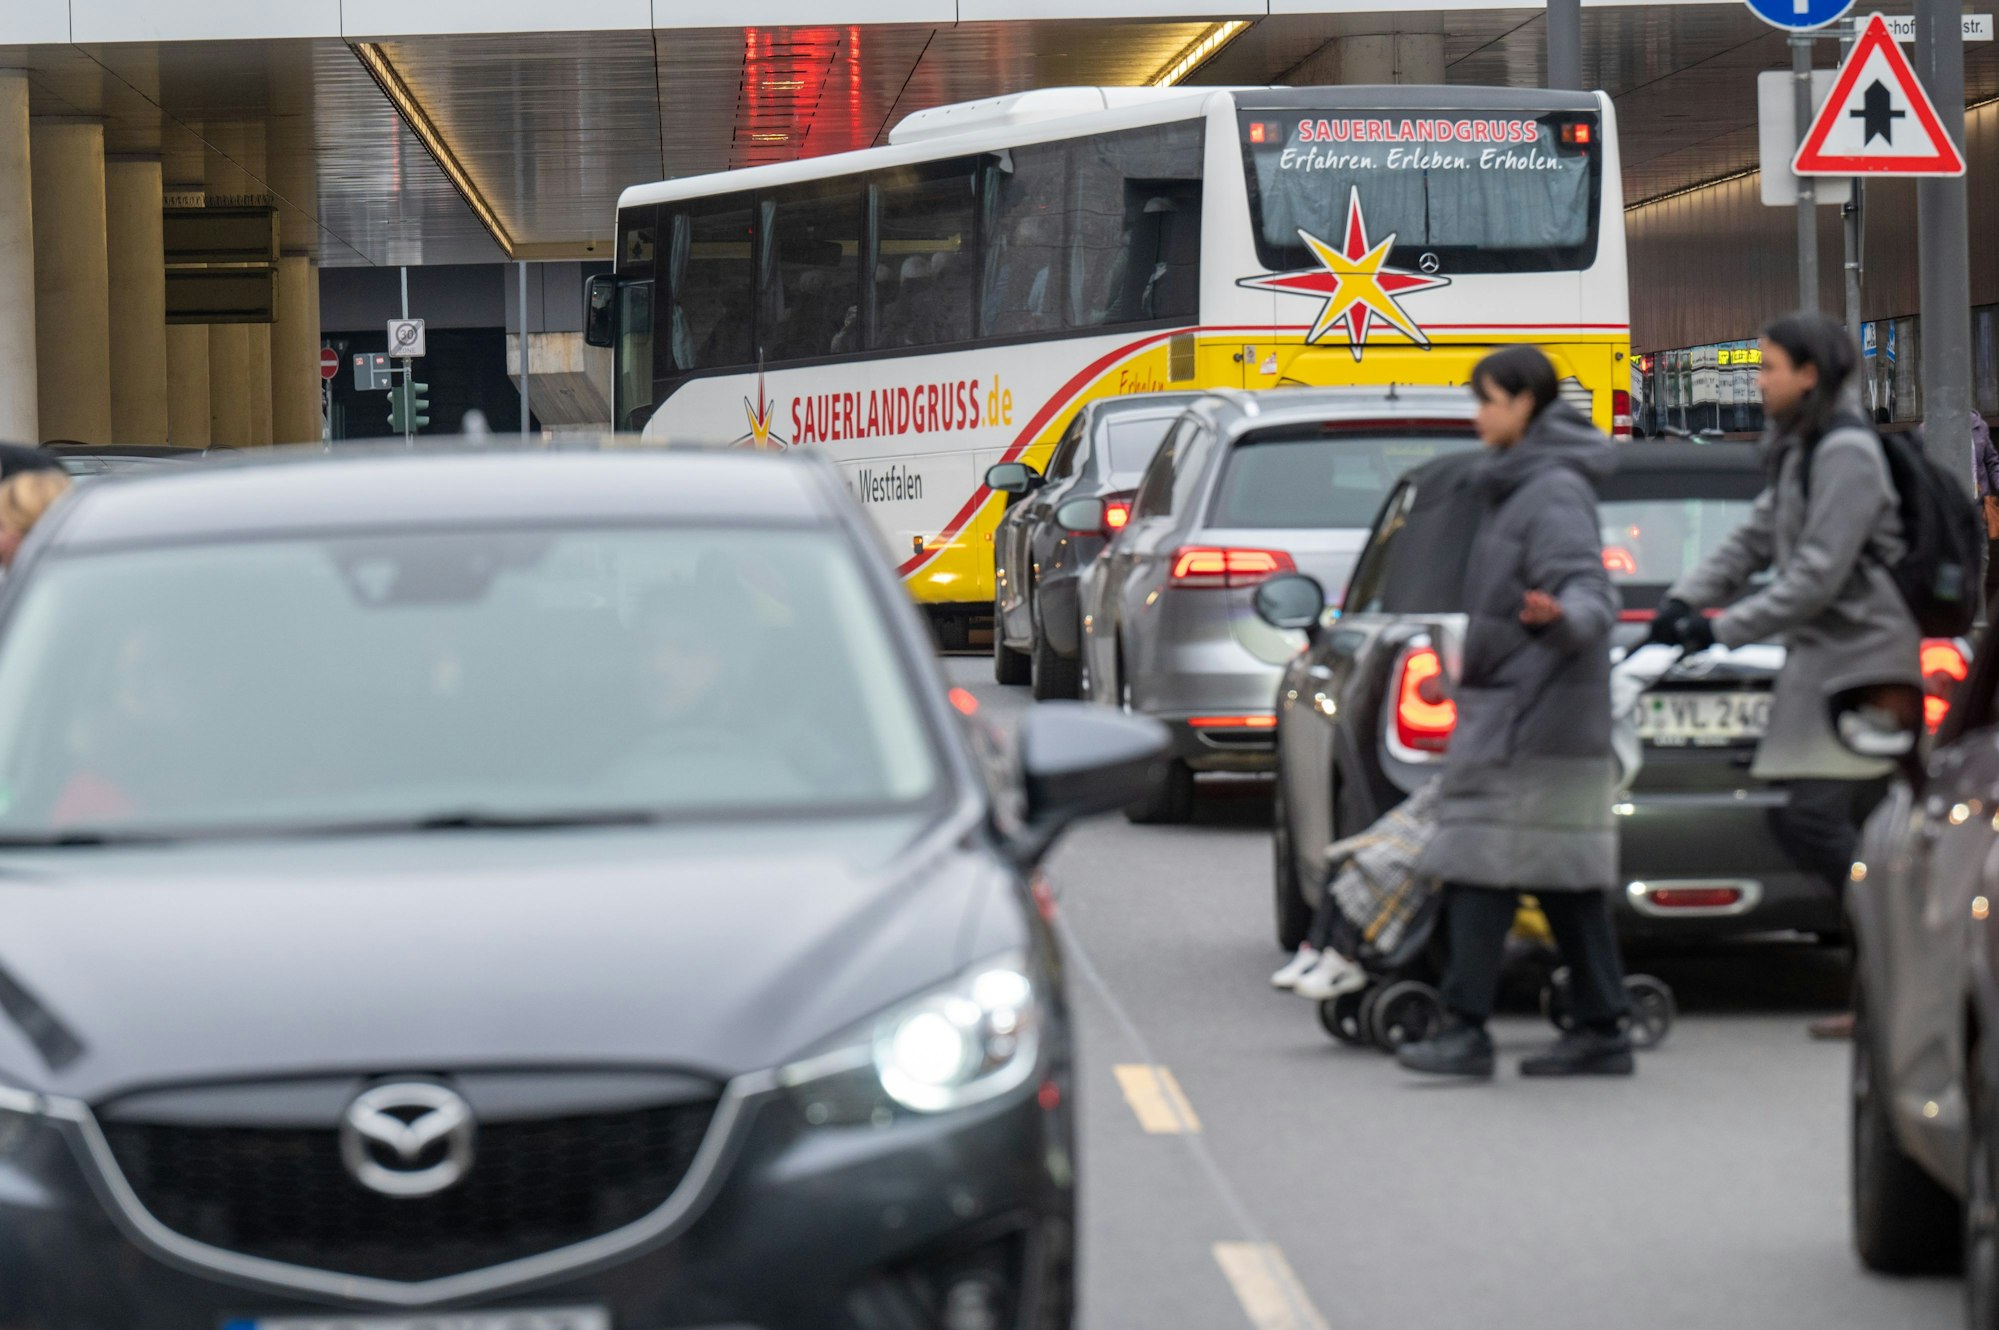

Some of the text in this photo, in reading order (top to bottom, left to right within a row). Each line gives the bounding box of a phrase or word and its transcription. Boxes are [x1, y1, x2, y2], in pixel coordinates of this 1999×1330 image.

[1298, 119, 1539, 142] SAUERLANDGRUSS
[1279, 147, 1564, 172] Erfahren. Erleben. Erholen.
[400, 329, 414, 341] 30
[791, 374, 1013, 445] SAUERLANDGRUSS.de
[858, 465, 923, 504] Westfalen
